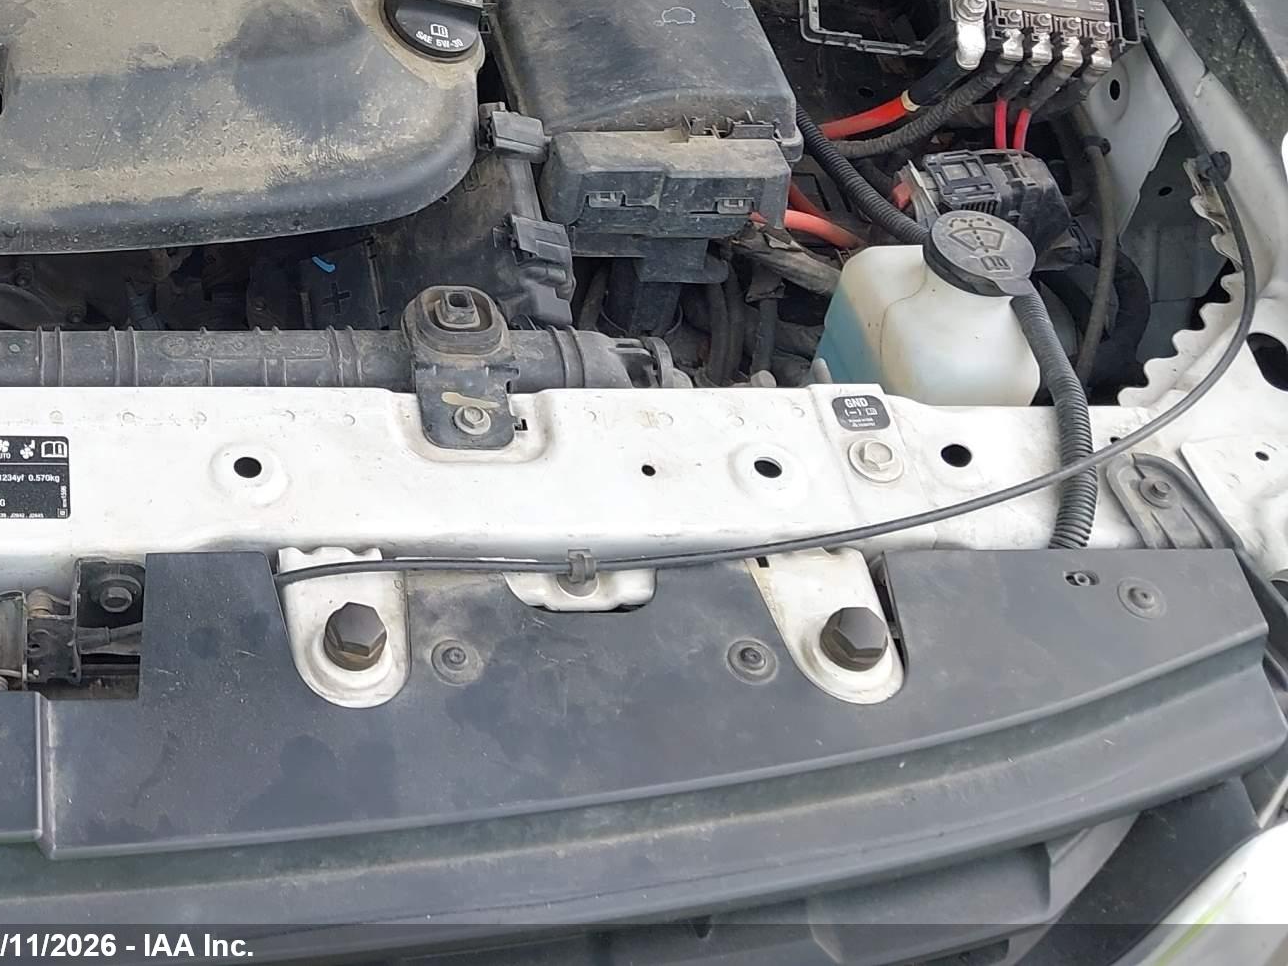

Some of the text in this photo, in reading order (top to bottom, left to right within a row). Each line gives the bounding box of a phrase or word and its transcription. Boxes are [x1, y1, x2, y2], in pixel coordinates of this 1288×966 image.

[415, 30, 433, 44] SAE
[844, 397, 869, 408] GND
[28, 474, 60, 483] 0.570kg
